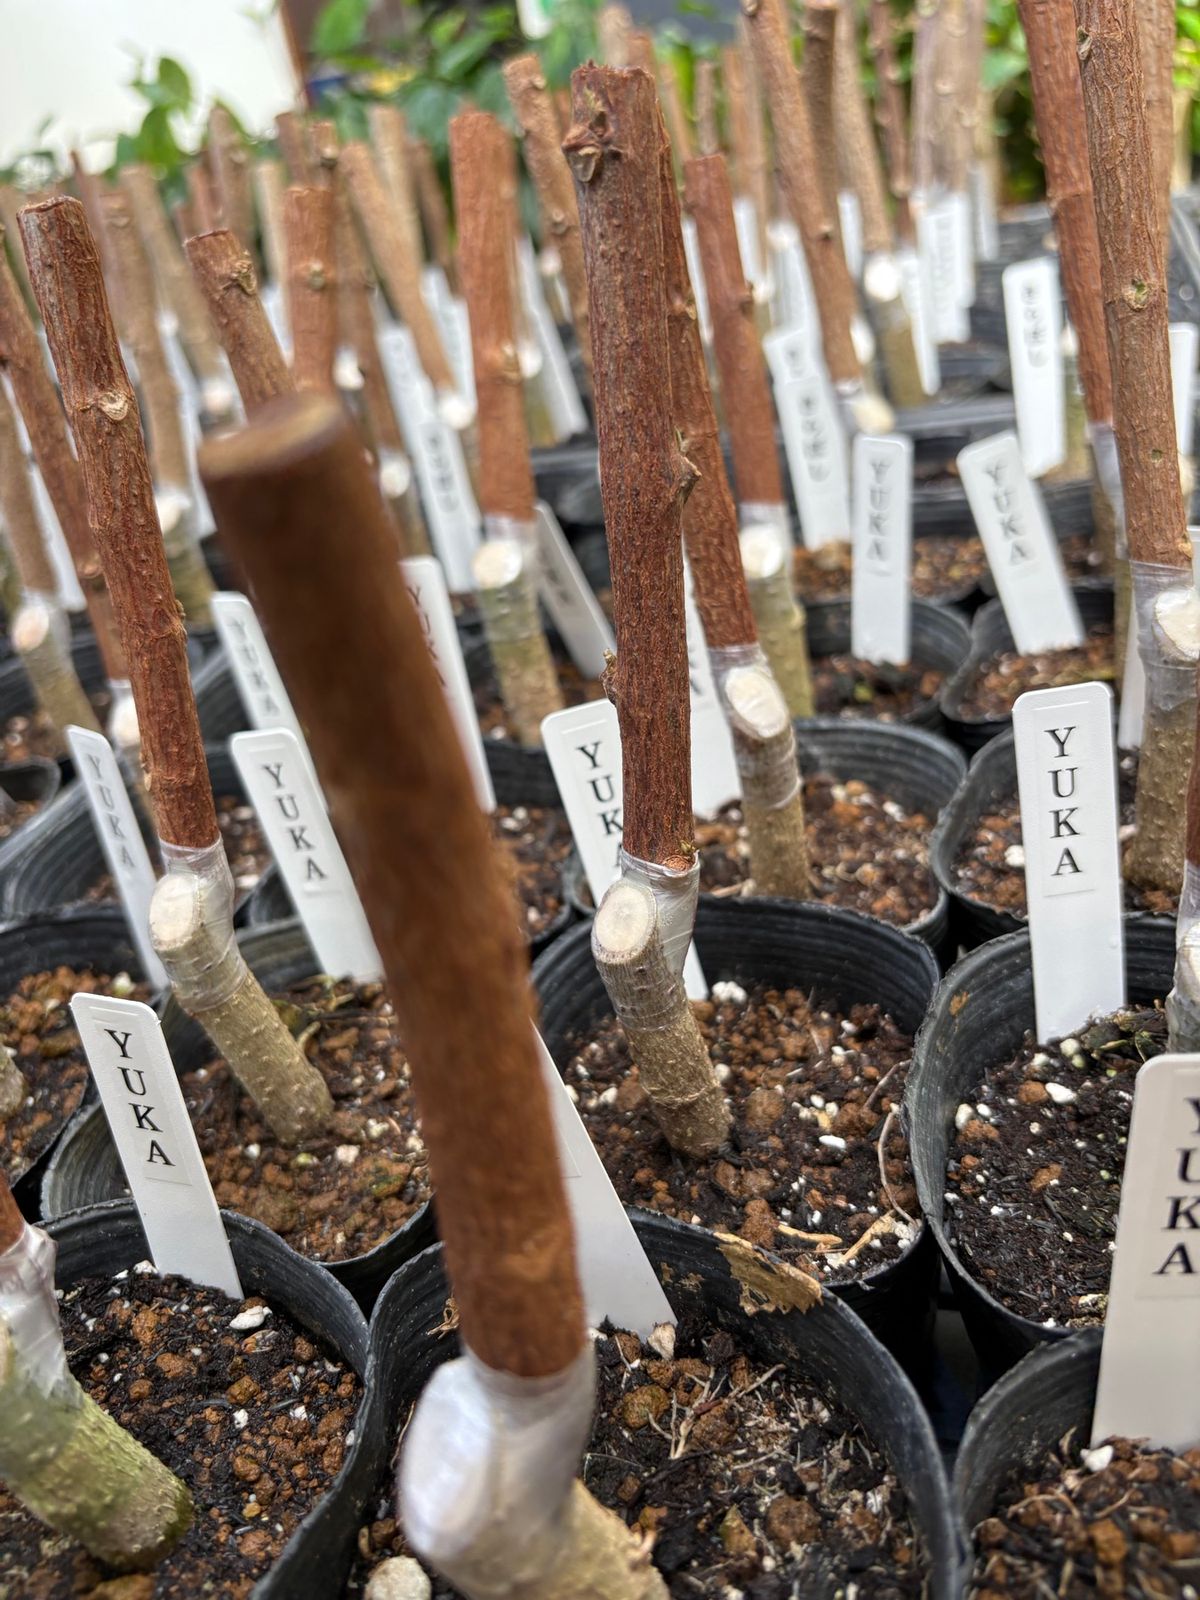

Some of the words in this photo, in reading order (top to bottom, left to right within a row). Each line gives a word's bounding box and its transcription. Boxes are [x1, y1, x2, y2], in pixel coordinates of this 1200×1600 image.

[87, 753, 136, 868] YUKA
[261, 762, 327, 882] YUKA
[575, 740, 624, 868] YUK
[1044, 726, 1083, 876] YUKA
[103, 1028, 177, 1167] YUKA
